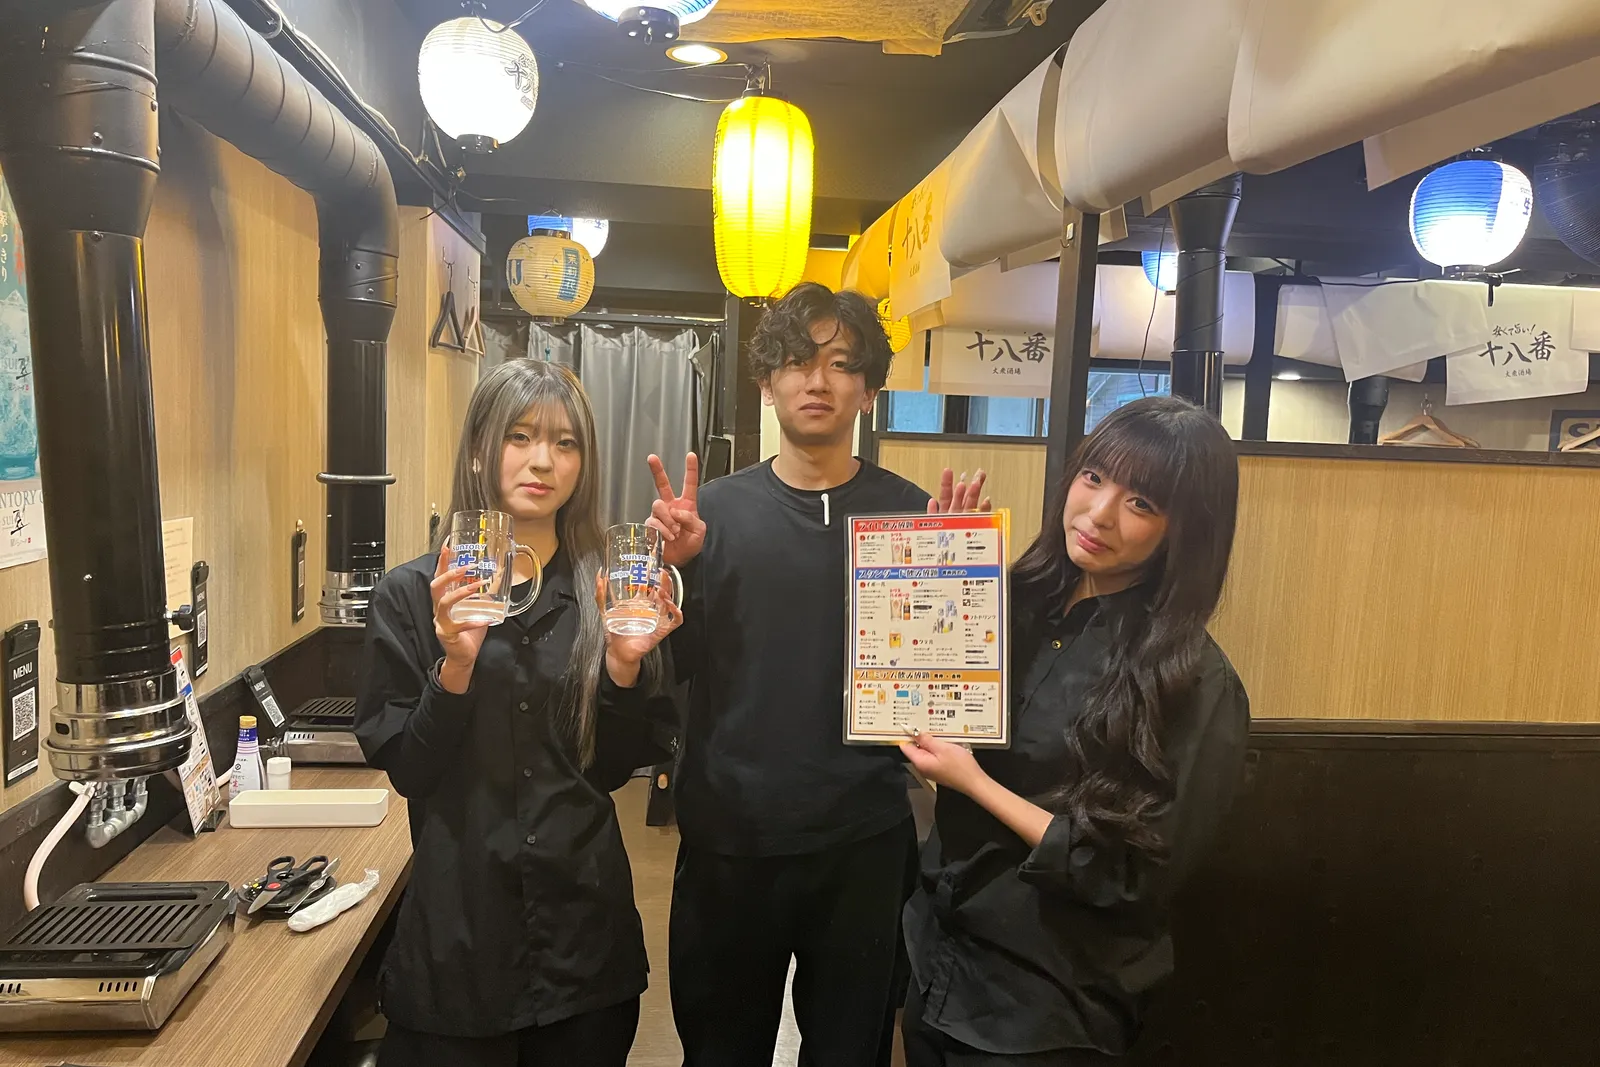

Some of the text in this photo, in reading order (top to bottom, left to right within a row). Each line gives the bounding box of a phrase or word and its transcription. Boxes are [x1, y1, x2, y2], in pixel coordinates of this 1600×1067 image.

[966, 331, 1050, 363] 十八番
[1478, 331, 1556, 367] 十八番
[992, 367, 1022, 375] 大衆酒場
[1505, 368, 1532, 377] 大衆酒場
[452, 544, 486, 552] SUNTORY
[478, 561, 496, 569] BEER
[630, 563, 648, 584] 生
[13, 662, 33, 680] MENU
